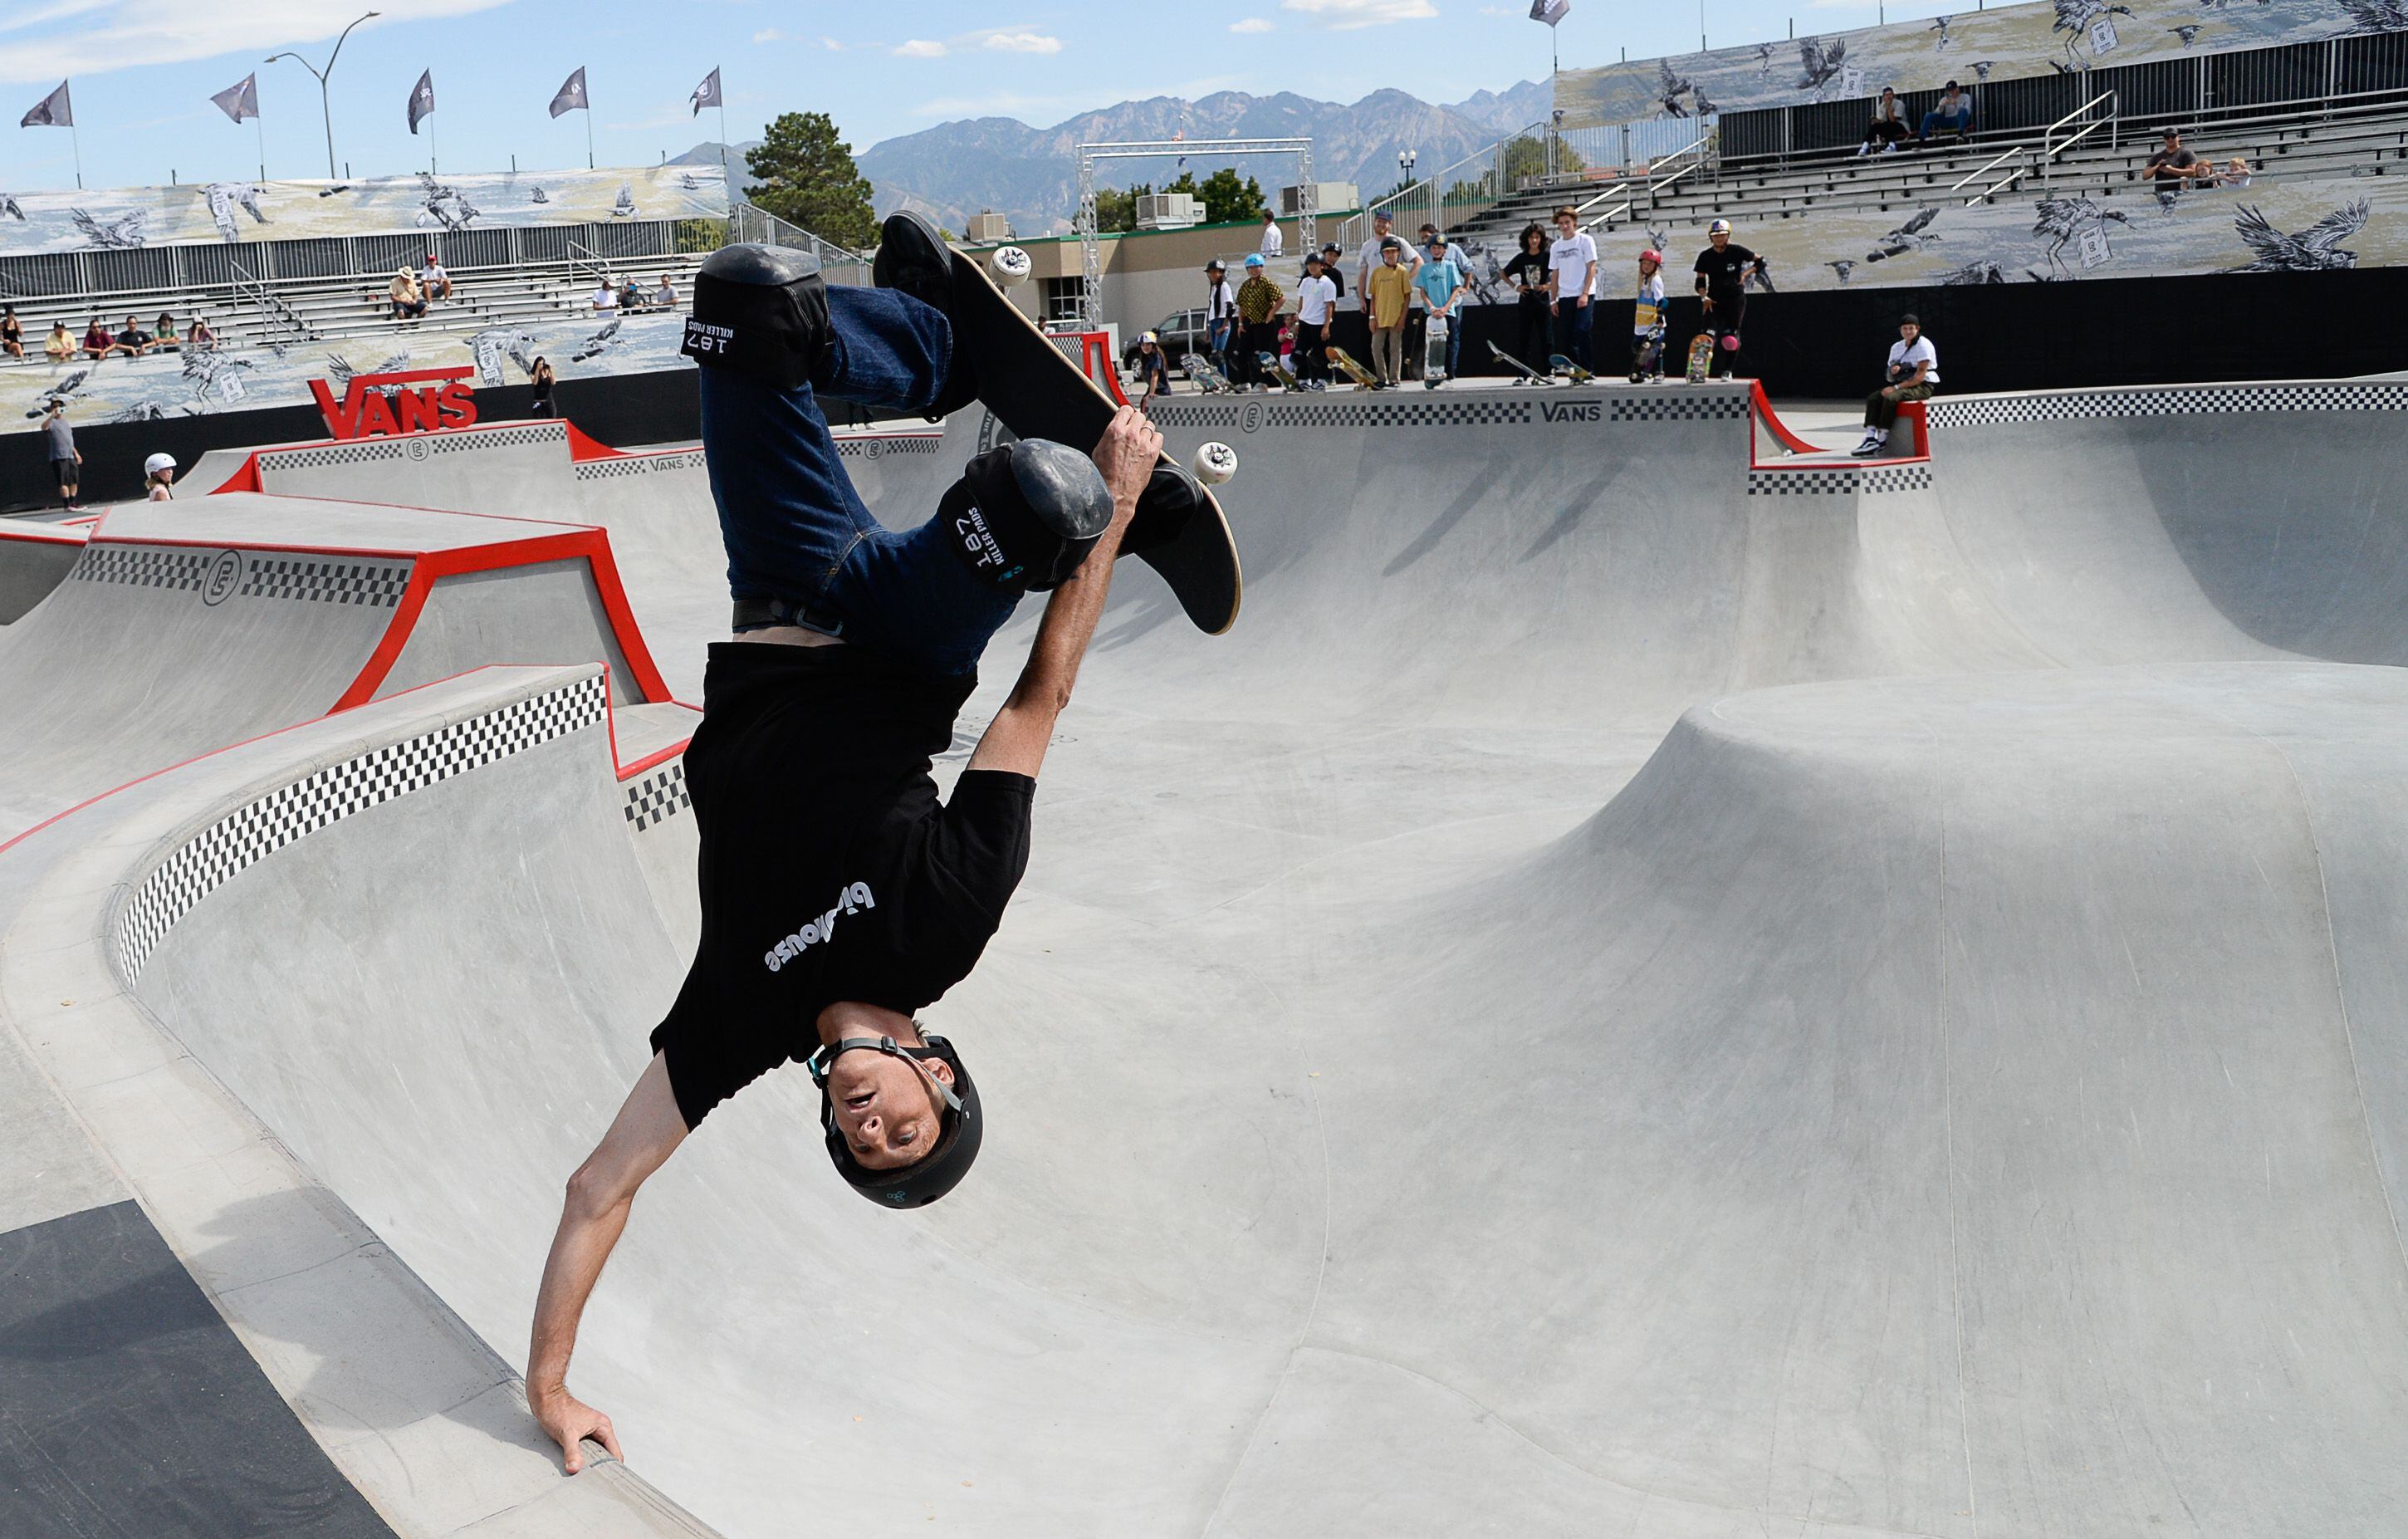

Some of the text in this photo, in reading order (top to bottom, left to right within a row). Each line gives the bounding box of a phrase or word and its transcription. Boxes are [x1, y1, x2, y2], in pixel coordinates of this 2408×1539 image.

[688, 321, 734, 338] KILLER PADS
[688, 333, 727, 354] 187
[306, 366, 477, 440] VANS
[1539, 400, 1603, 423] VANS
[648, 456, 684, 472] VANS
[956, 518, 992, 567] 187
[968, 507, 1005, 566] KILLER PADS
